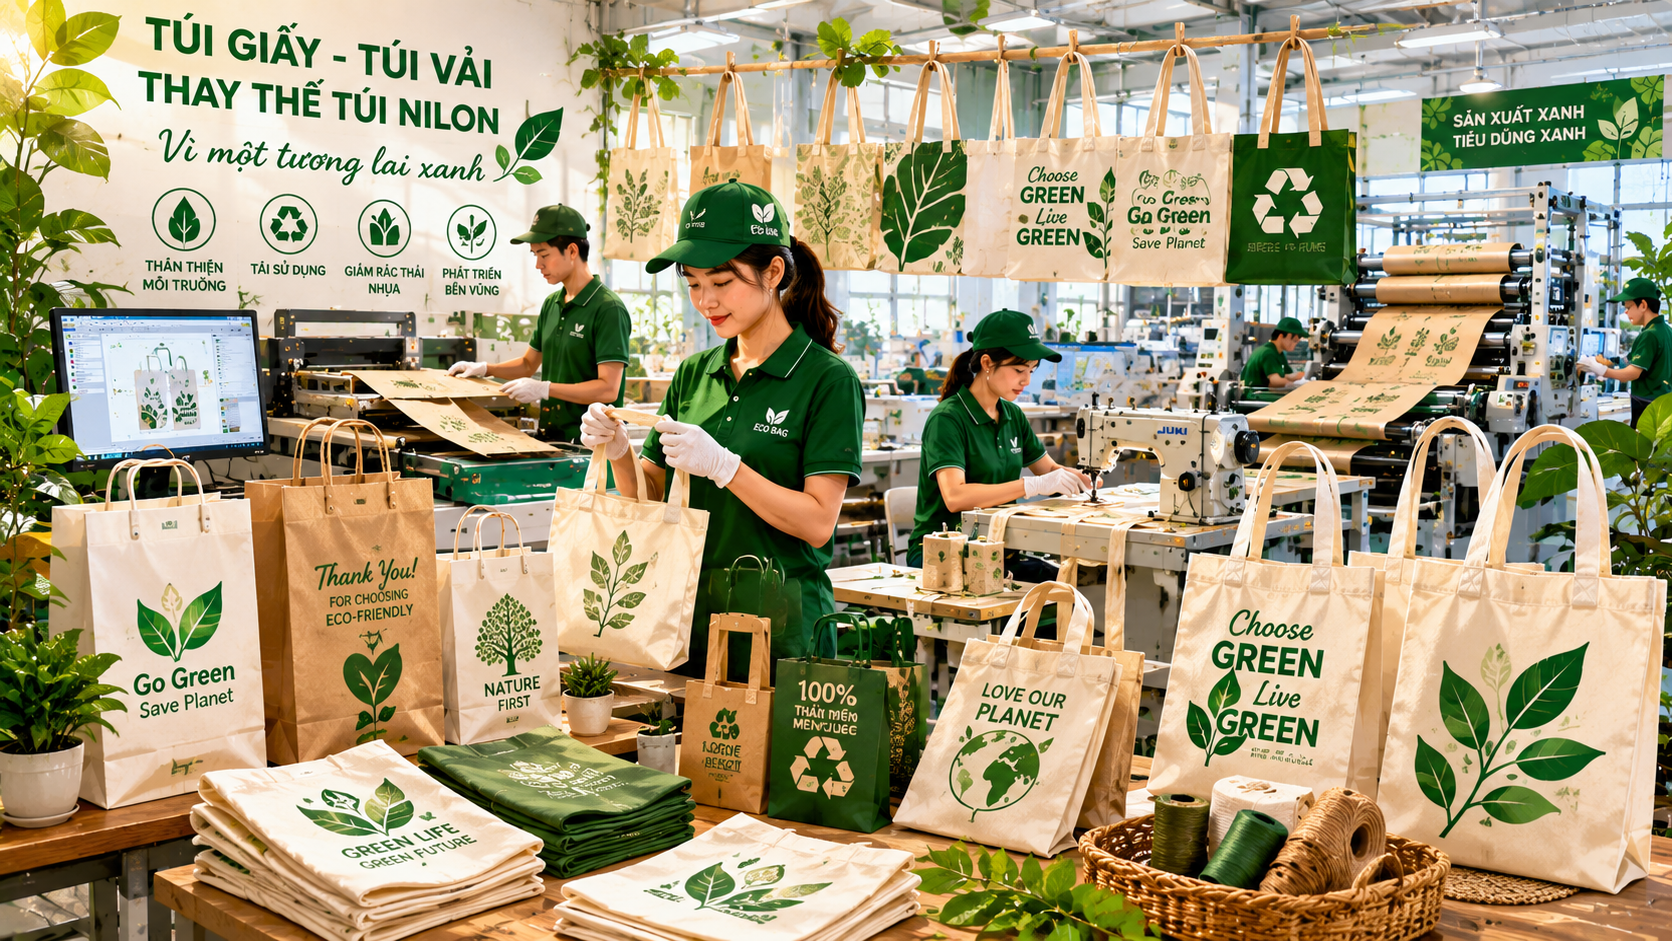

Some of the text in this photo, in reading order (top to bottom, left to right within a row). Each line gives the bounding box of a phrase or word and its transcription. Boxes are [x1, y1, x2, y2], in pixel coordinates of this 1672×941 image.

[145, 12, 213, 57] TÚI
[227, 22, 321, 68] GIẤY
[358, 39, 418, 81] TÚI
[430, 45, 492, 89] VẢI
[138, 70, 499, 135] THAY THẾ TÚI NILON
[1537, 104, 1585, 122] XANH
[1540, 126, 1586, 143] XANH
[158, 128, 487, 186] Vì một tương lai xanh
[1027, 166, 1078, 184] Choose
[1020, 186, 1085, 205] GREEN
[1035, 207, 1068, 227] Live
[1157, 207, 1211, 224] Green
[1016, 227, 1081, 247] GREEN
[1132, 236, 1206, 249] Save Planet
[753, 422, 789, 438] ECO BAG
[1157, 426, 1187, 435] JUKI
[314, 556, 419, 591] Thank You!
[329, 588, 409, 608] FOR CHOOSING
[326, 603, 414, 626] ECO-FRIENDLY
[1229, 608, 1314, 641] Choose
[1211, 640, 1325, 679] GREEN
[133, 664, 235, 696] Go Green
[484, 675, 541, 697] NATURE
[798, 679, 857, 707] 100%
[139, 688, 234, 719] Save Planet
[498, 695, 531, 712] FIRST
[981, 682, 1067, 710] LOVE OUR
[1253, 680, 1302, 709] Live
[975, 702, 1059, 732] PLANET
[1216, 708, 1320, 748] GREEN
[341, 822, 461, 860] GREEN LIFE
[359, 834, 477, 871] GREEN FUTURE
